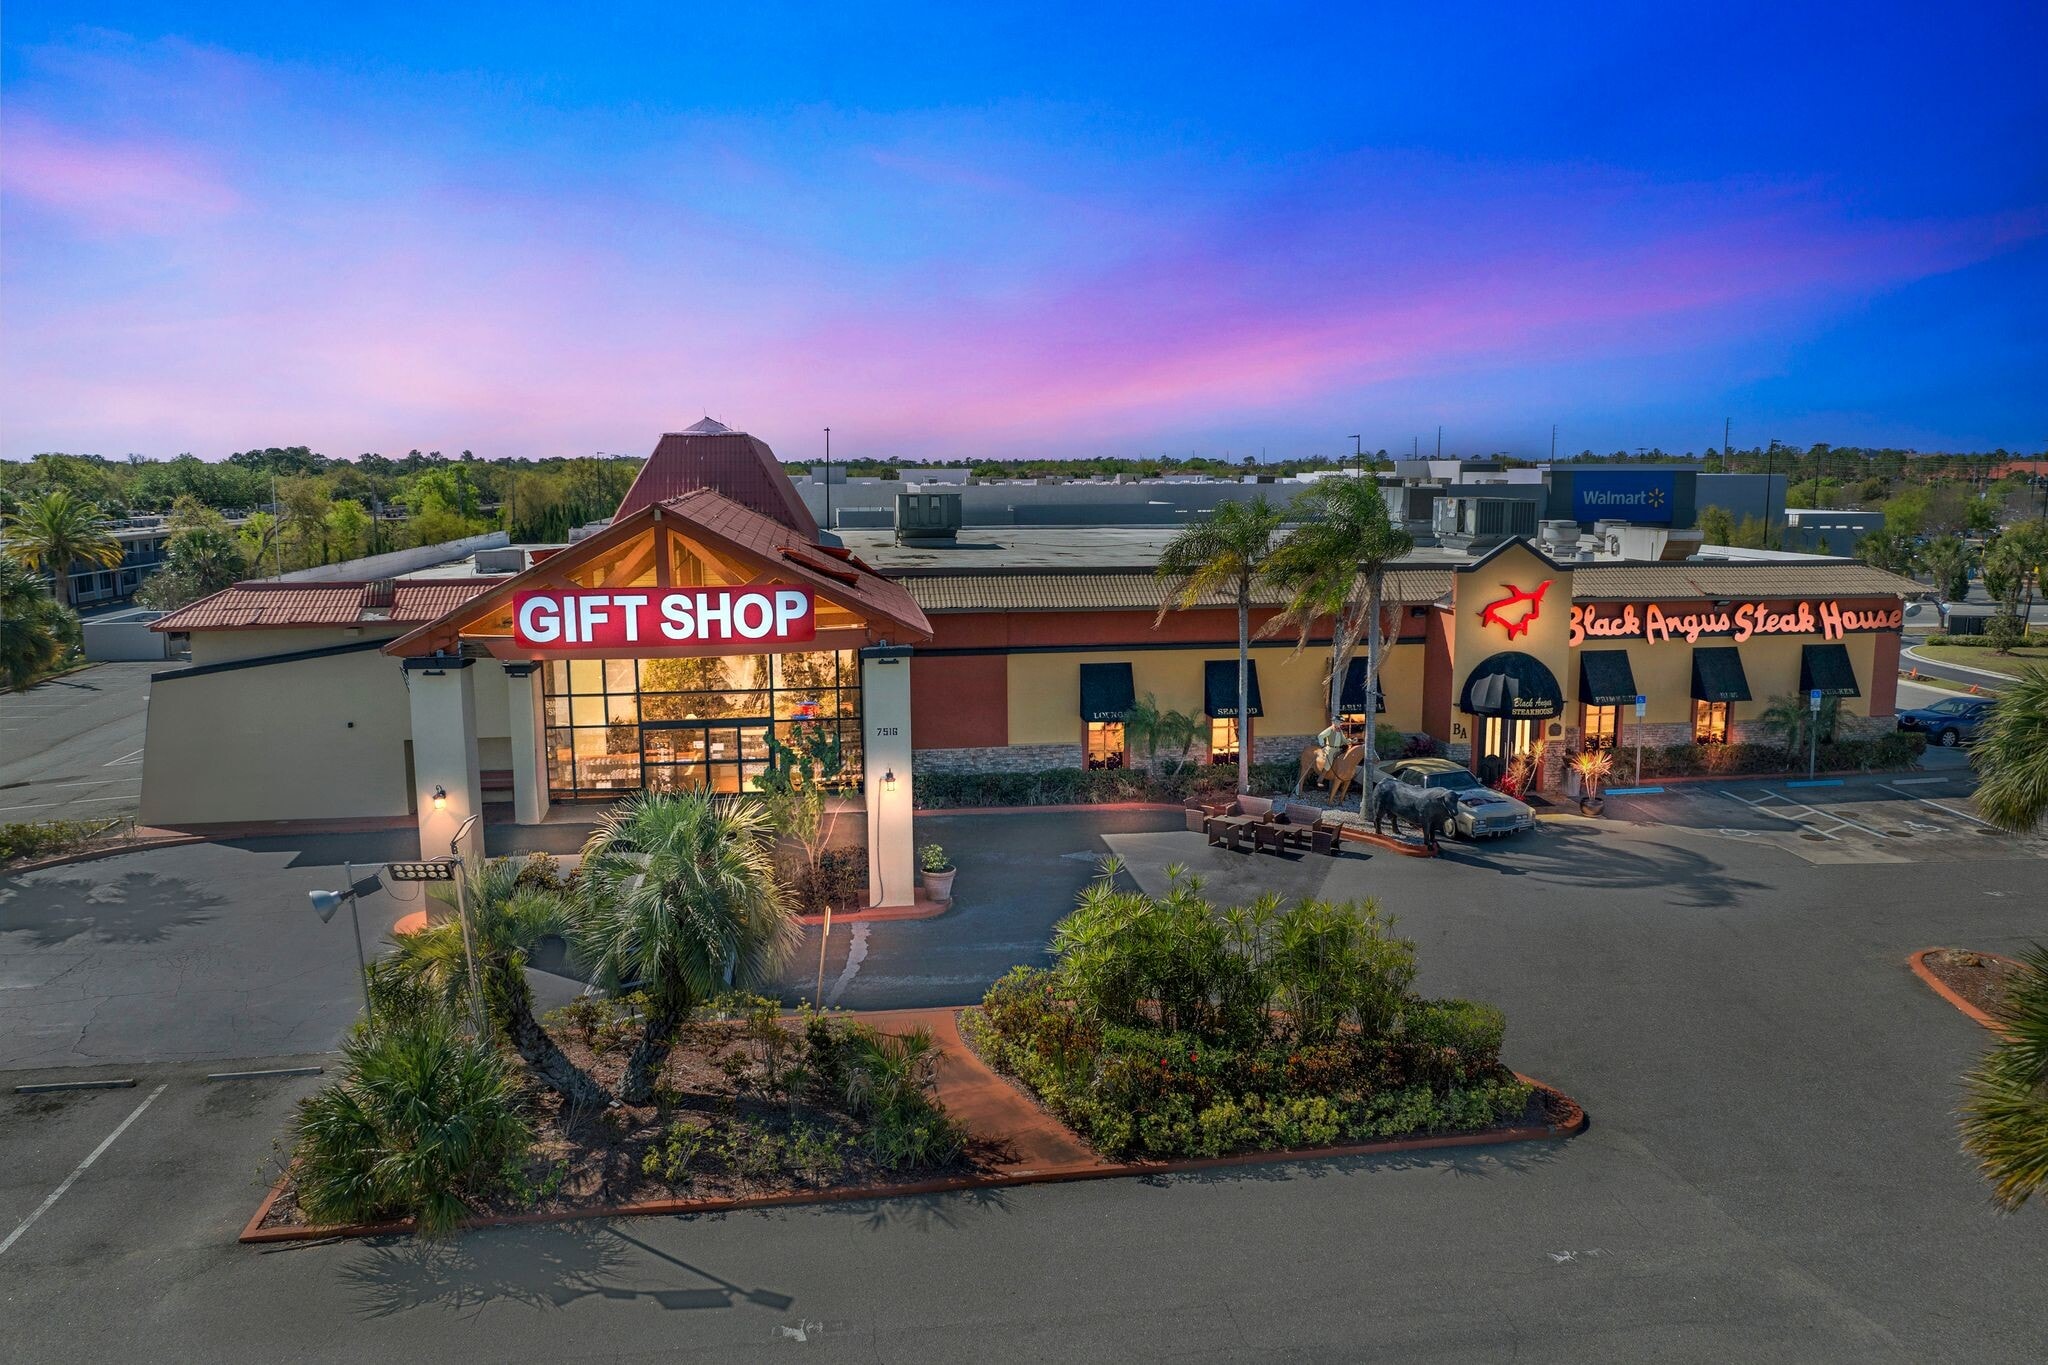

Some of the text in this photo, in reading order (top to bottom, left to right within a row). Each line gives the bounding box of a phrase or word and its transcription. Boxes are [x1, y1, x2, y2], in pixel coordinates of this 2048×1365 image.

[1583, 490, 1646, 505] Walmart
[518, 590, 808, 643] GIFT SHOP
[1568, 600, 1902, 648] Black Angus Steak House
[1513, 697, 1533, 708] Black
[1217, 707, 1258, 715] SEAFOD
[1511, 708, 1554, 716] STEAKHOUSE
[876, 727, 898, 736] 7516
